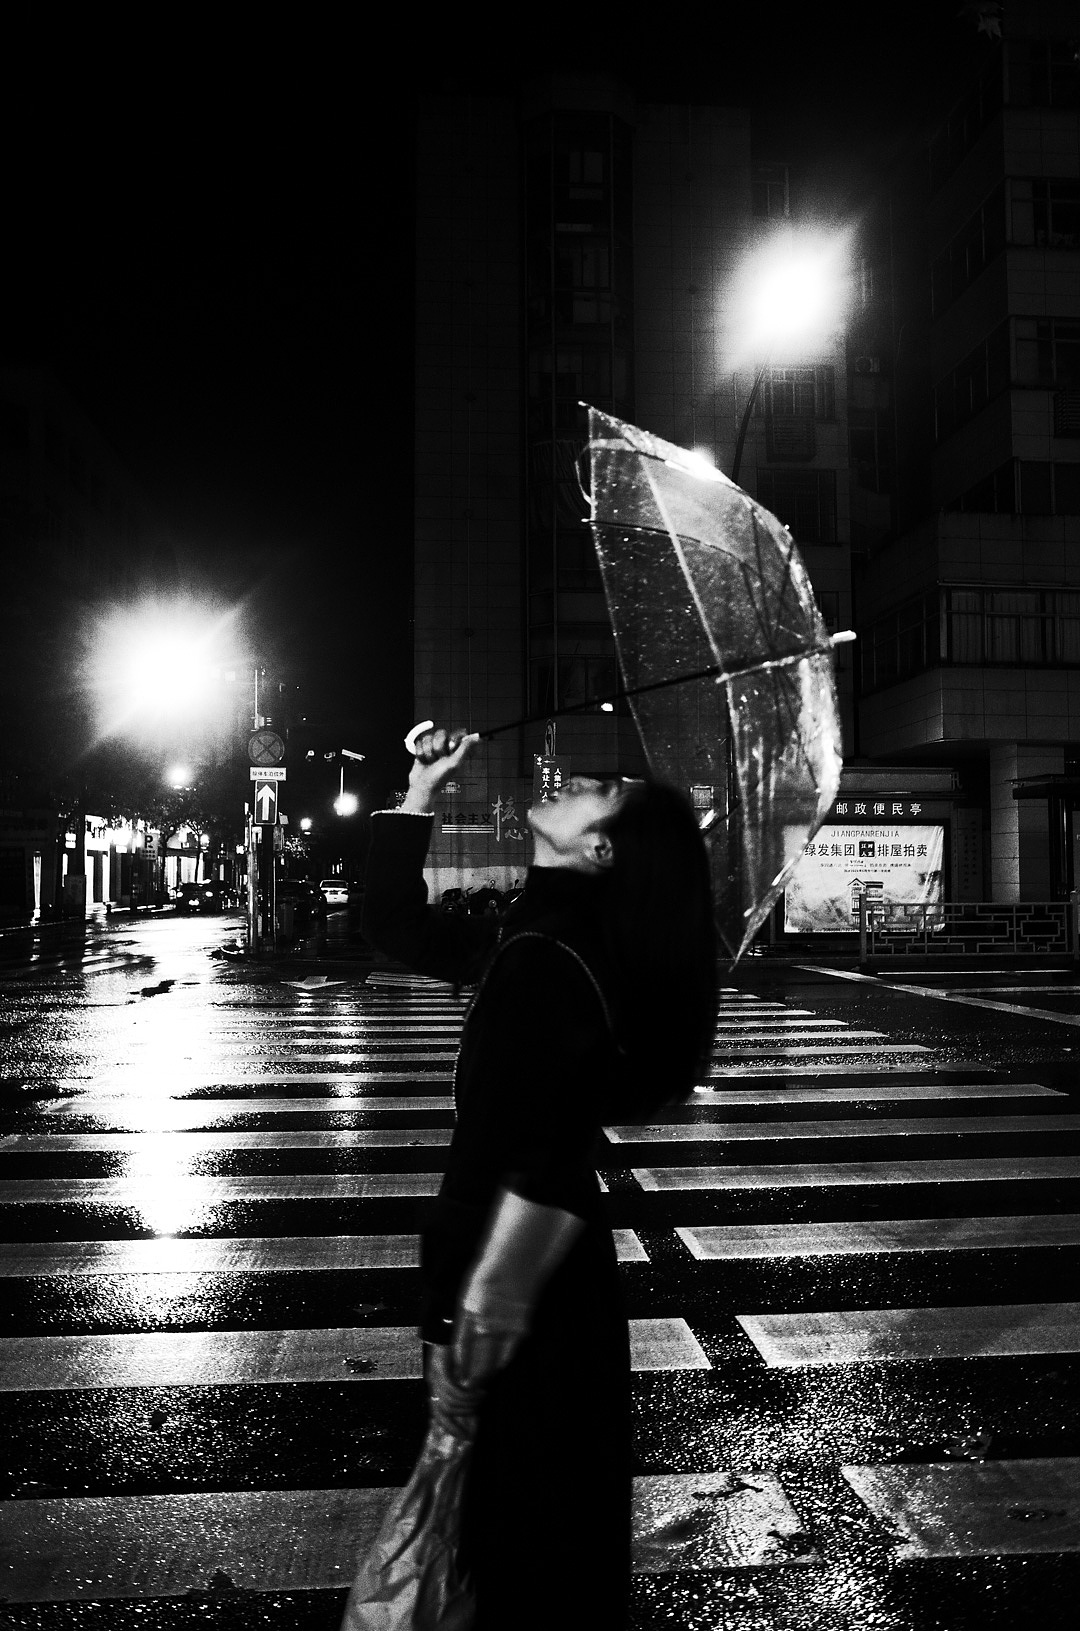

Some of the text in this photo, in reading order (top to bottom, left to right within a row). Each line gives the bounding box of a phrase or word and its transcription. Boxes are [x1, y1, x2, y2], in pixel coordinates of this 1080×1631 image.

[836, 802, 922, 816] 邮政便民亭
[441, 795, 529, 842] 社会主义 核心
[831, 830, 900, 838] JIANGPANRENJIA
[804, 843, 855, 857] 绿发集团
[877, 843, 928, 857] 排屋拍卖
